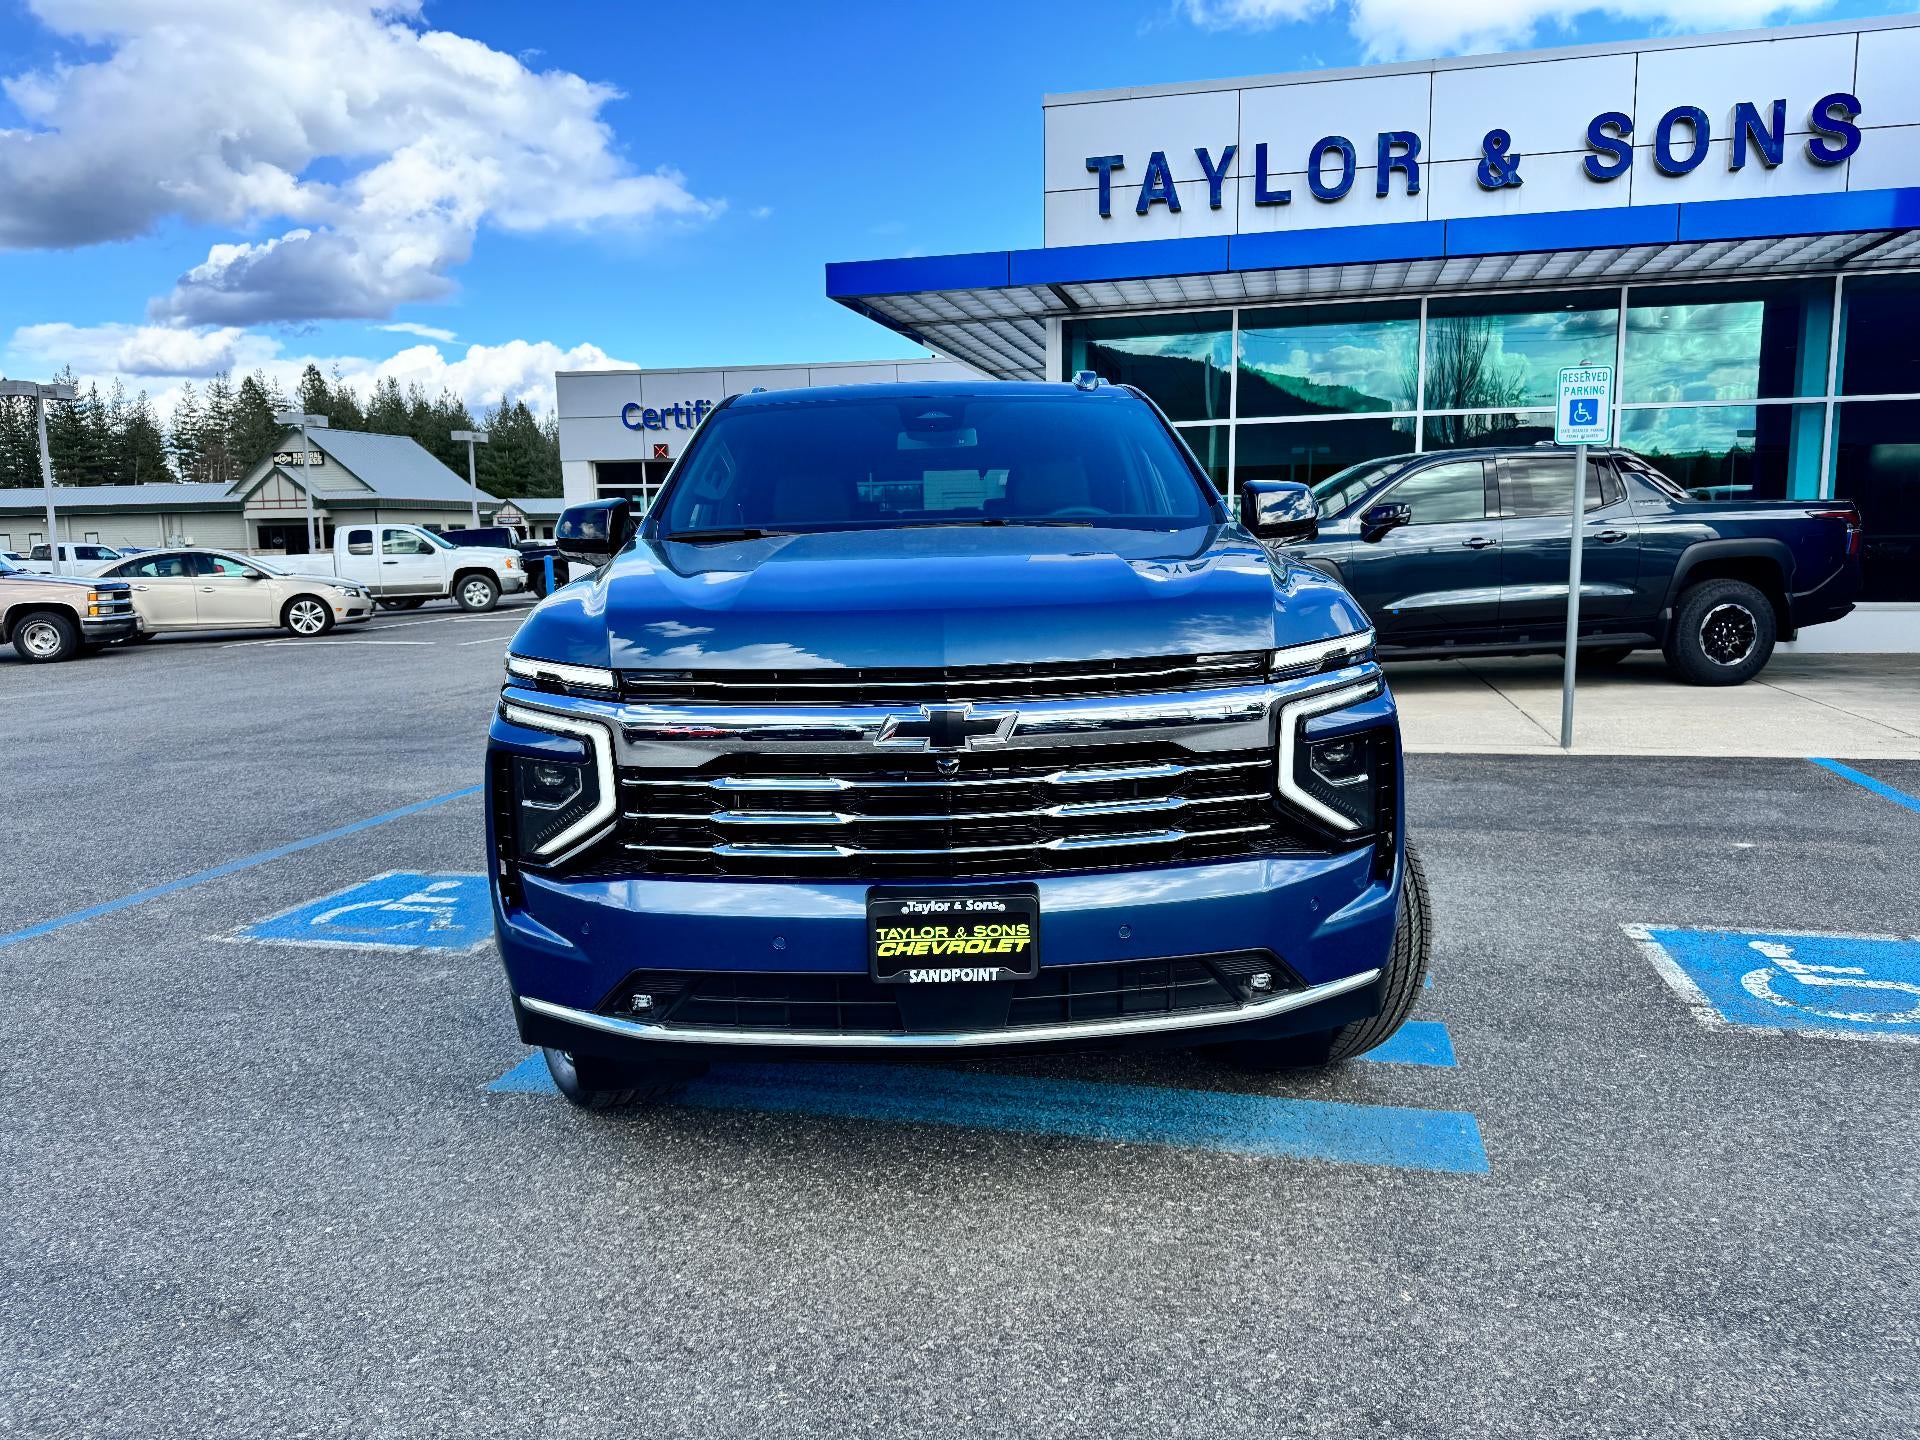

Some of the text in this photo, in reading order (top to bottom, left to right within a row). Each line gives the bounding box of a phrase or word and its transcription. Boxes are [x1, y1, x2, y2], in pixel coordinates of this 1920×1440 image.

[1085, 92, 1863, 219] TAYLOR & SONS
[1562, 371, 1608, 383] RESERVED
[1564, 385, 1605, 396] PARKING
[907, 900, 999, 914] Taylor & Sons
[876, 923, 1030, 940] TAYLOR & SONS
[877, 938, 1030, 956] CHEVROLET
[909, 967, 1000, 983] SANDPOINT
